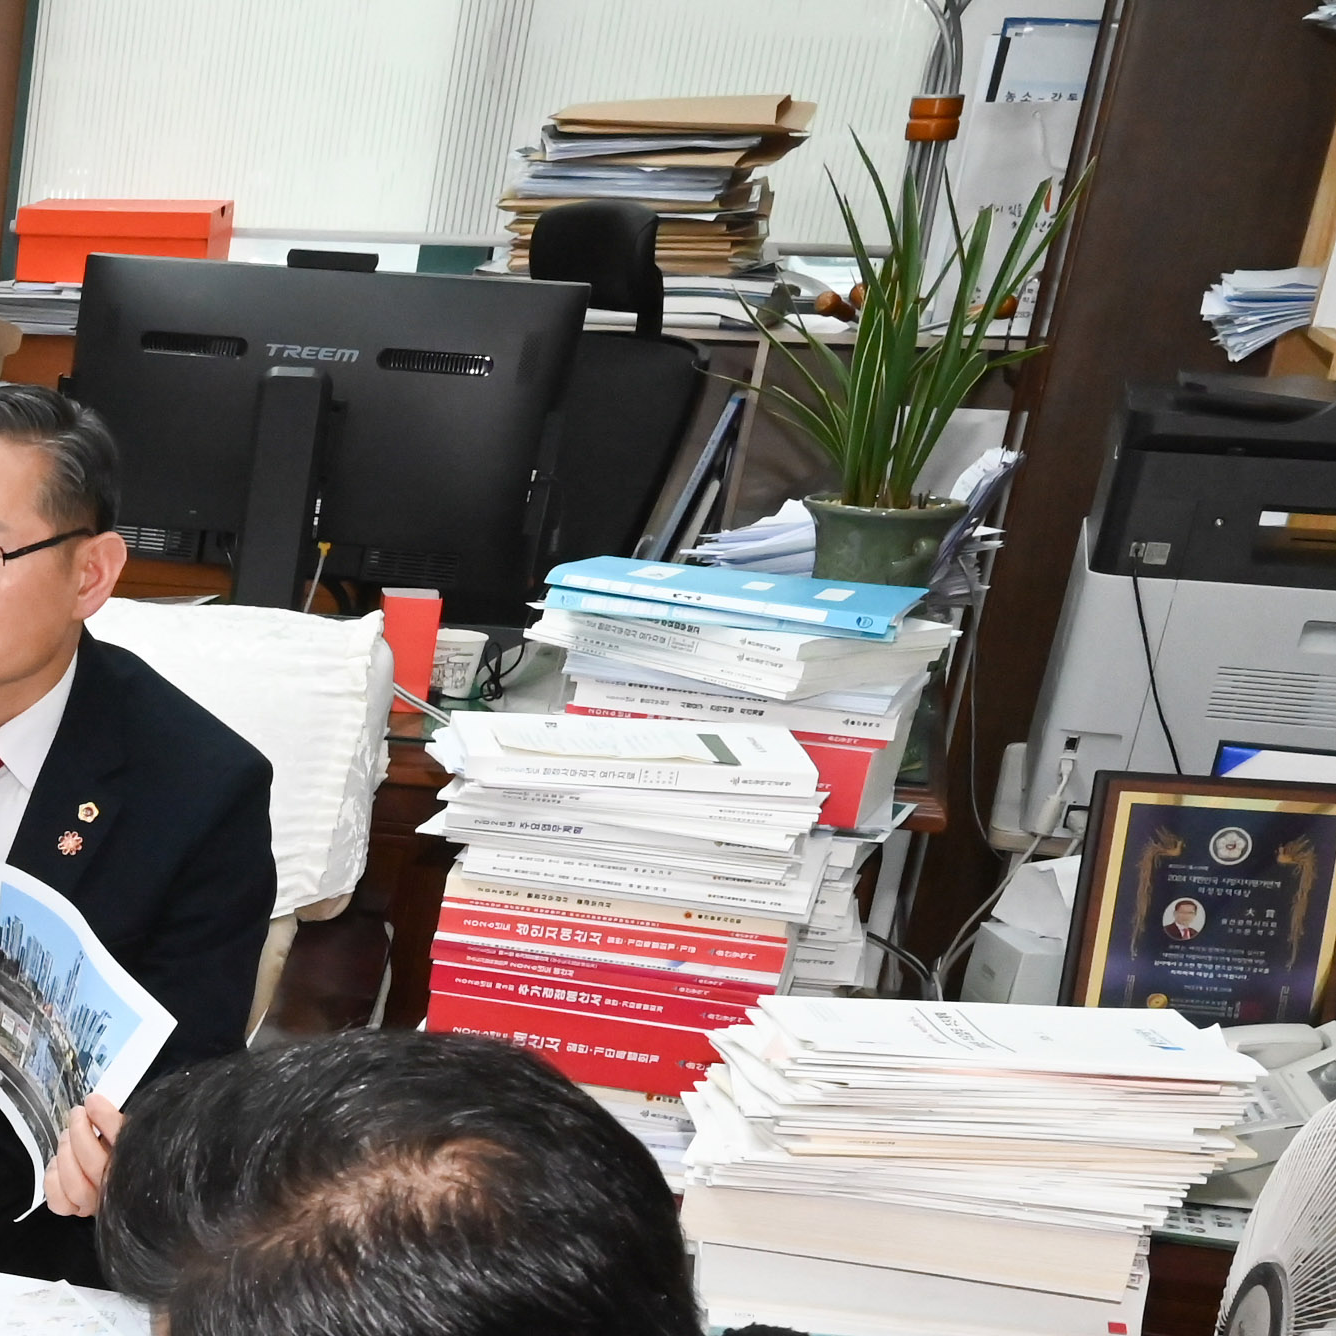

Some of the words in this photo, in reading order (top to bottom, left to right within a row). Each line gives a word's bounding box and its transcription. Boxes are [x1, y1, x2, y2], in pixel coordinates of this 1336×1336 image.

[266, 342, 359, 364] TREEM
[515, 922, 604, 946] 성인지예산서
[517, 982, 604, 1008] 추가경정예산서
[514, 1032, 563, 1054] 예산서
[566, 1042, 662, 1065] 일반·기타특별회계
